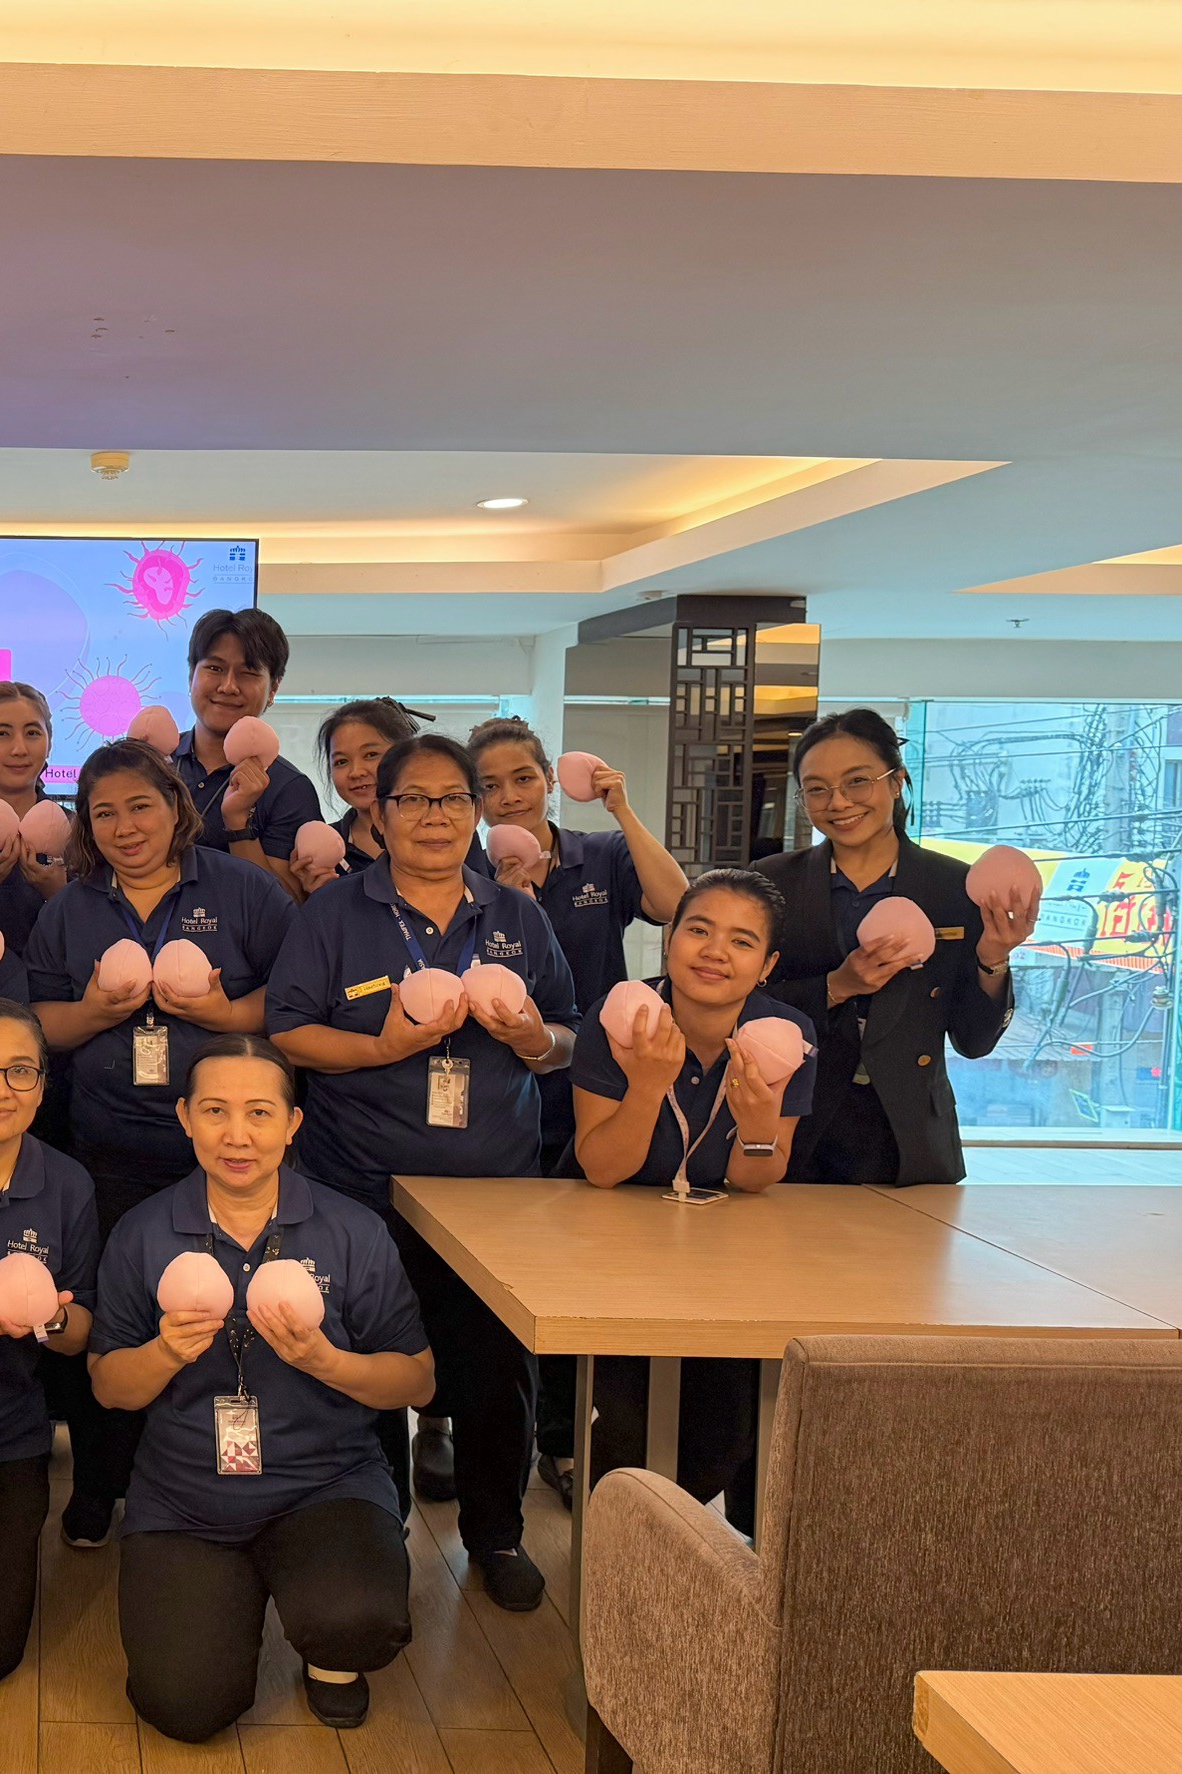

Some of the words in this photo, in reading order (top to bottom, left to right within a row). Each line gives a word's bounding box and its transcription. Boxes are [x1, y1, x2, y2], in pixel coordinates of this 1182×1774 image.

[213, 564, 235, 572] Hotel
[238, 564, 253, 574] Roy
[45, 768, 77, 779] Hotel
[181, 916, 198, 925] Hotel
[200, 916, 218, 926] Royal
[501, 941, 522, 950] Royal
[7, 1240, 27, 1250] Hotel
[30, 1243, 49, 1255] Royal
